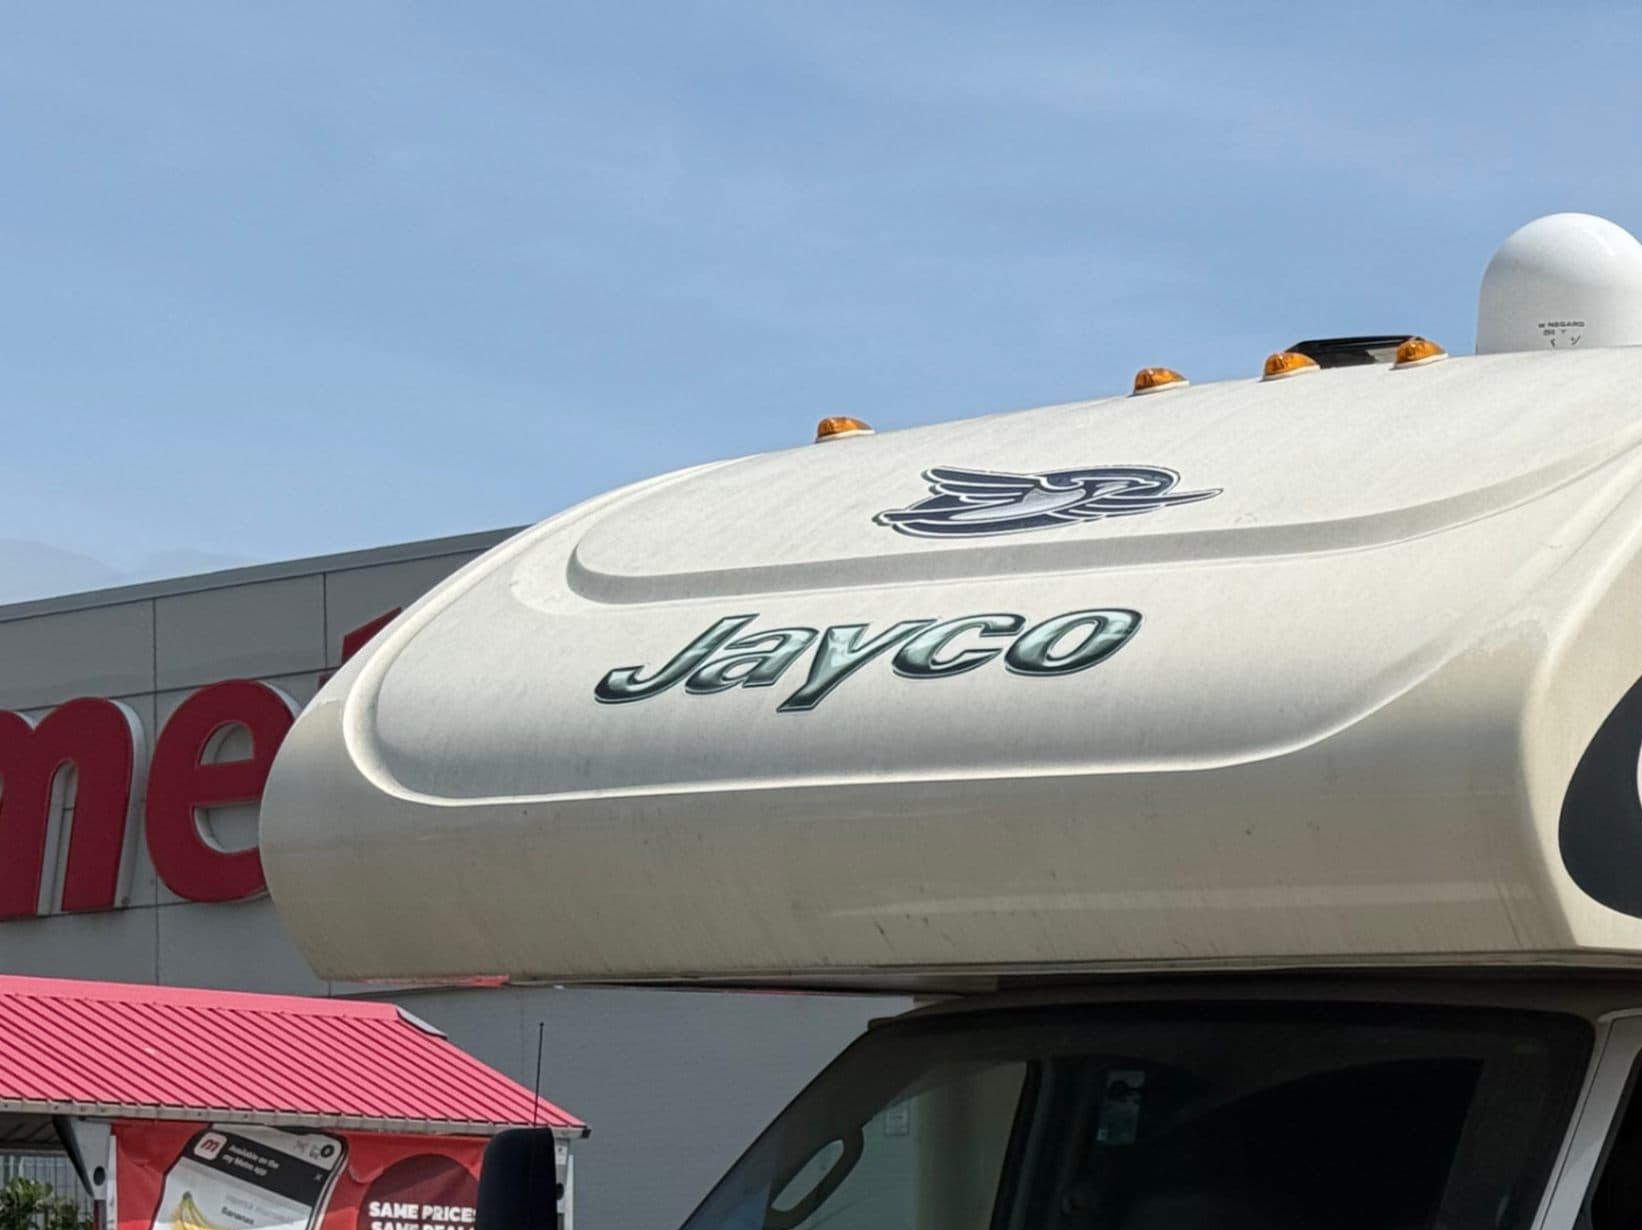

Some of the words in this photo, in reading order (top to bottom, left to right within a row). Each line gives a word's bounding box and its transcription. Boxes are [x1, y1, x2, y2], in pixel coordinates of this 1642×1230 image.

[595, 608, 1142, 712] Jayco
[0, 608, 401, 922] me
[369, 1202, 419, 1219] SAME
[422, 1205, 477, 1222] PRICE
